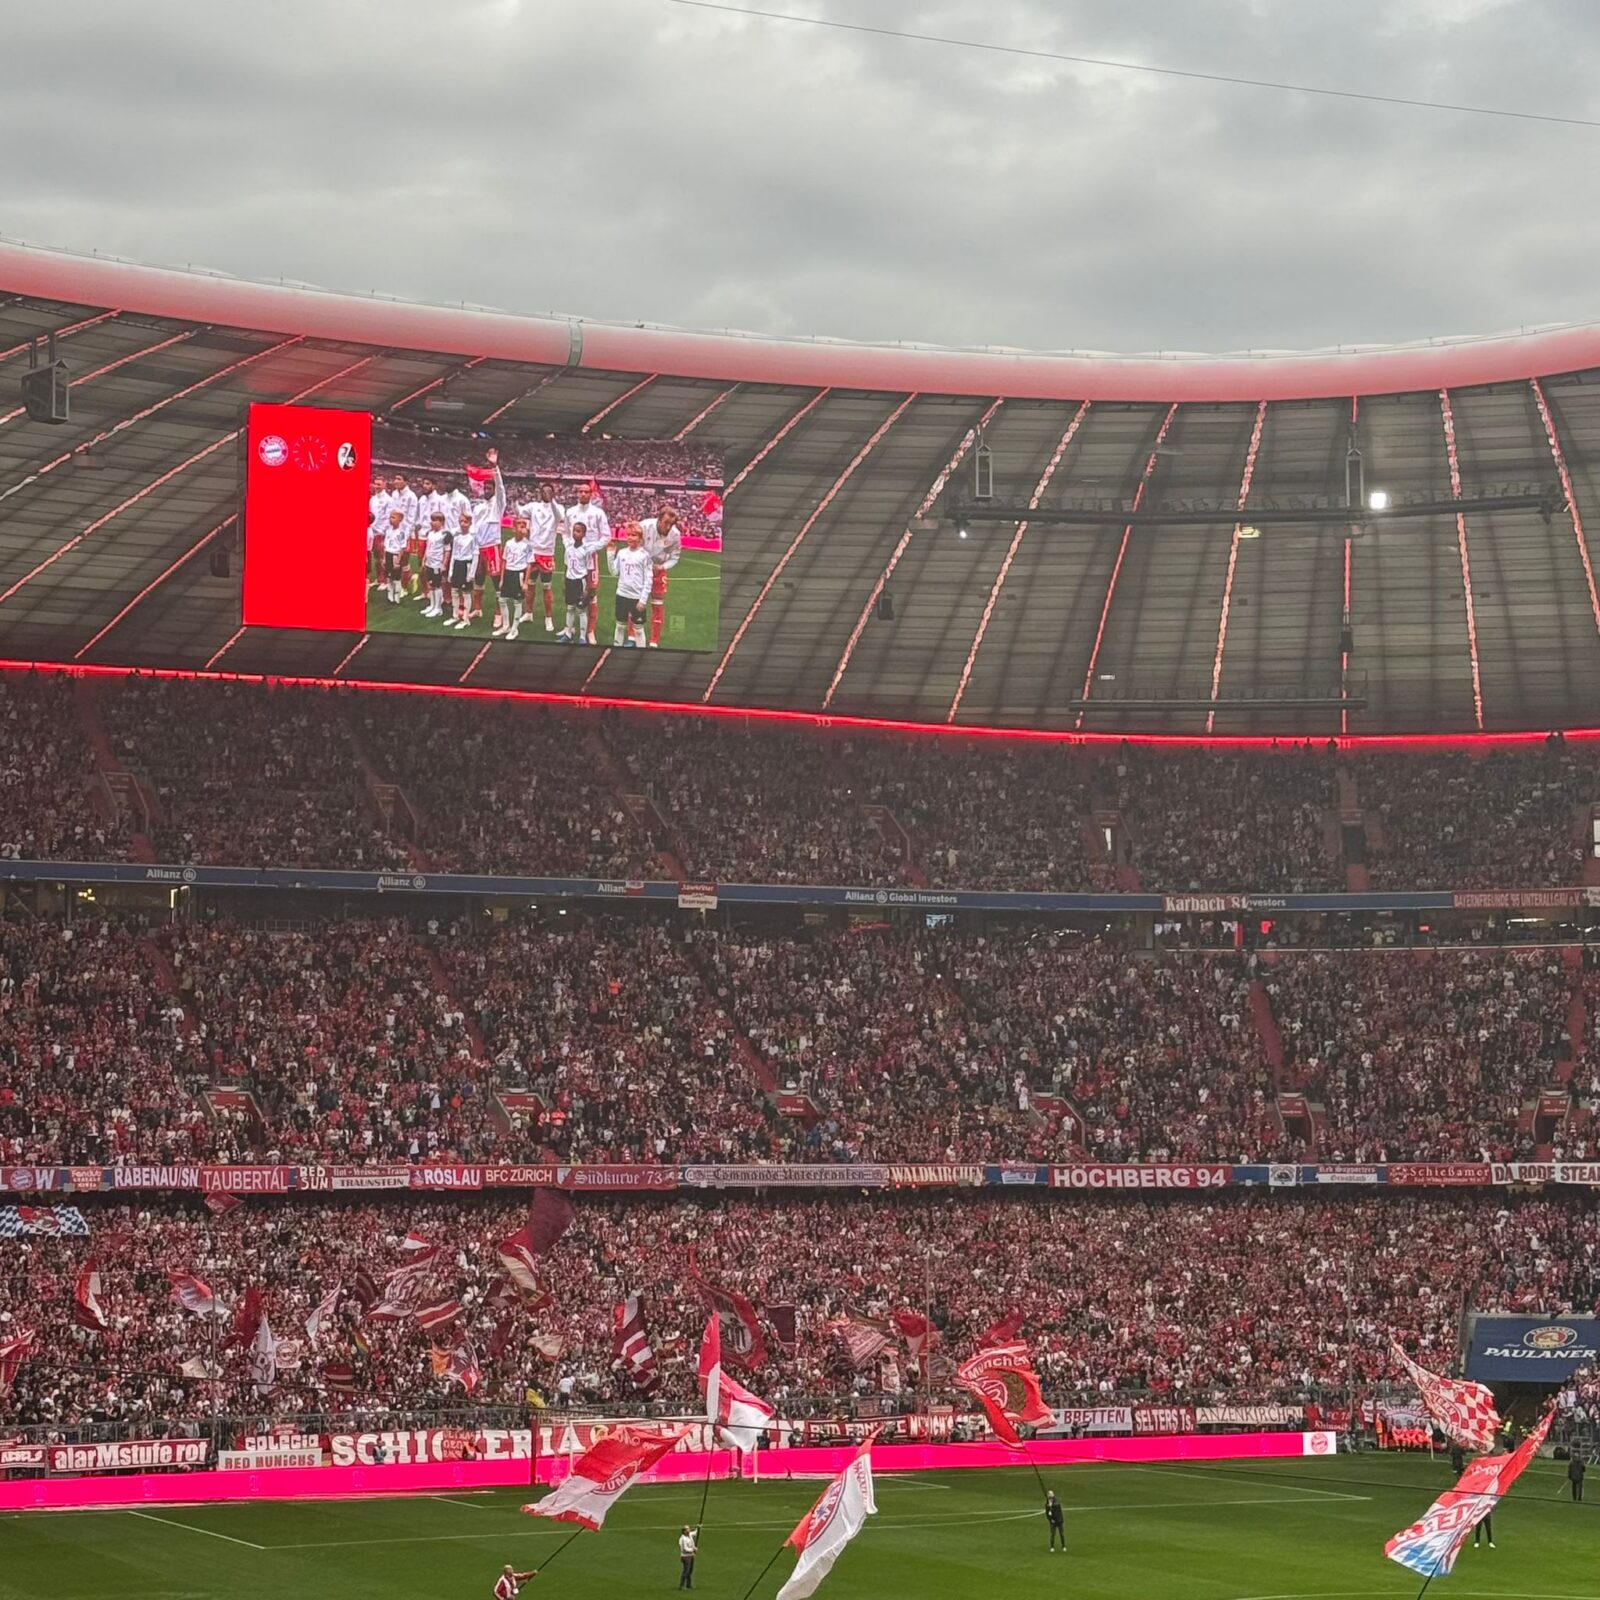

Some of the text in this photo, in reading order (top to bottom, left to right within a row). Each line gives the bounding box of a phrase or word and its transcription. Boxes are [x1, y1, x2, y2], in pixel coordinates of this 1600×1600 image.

[146, 868, 181, 879] Allianz
[377, 876, 410, 886] Allianz
[845, 891, 958, 903] Allianz Global Investors
[1247, 898, 1286, 907] vestors
[1165, 897, 1226, 911] Karbach
[114, 1167, 199, 1187] RABENAU/SN
[300, 1166, 326, 1177] RED
[485, 1169, 509, 1182] BFC
[574, 1170, 640, 1185] Südkurve
[1494, 1166, 1514, 1182] DA
[1560, 1166, 1600, 1182] STEA
[300, 1177, 328, 1190] SUN
[1483, 1347, 1597, 1359] PAULANER
[1064, 1409, 1125, 1424] BRETTEN
[1135, 1409, 1179, 1431] SELTERS
[176, 1441, 207, 1463] rot
[331, 1425, 585, 1467] SCHIERIA
[225, 1457, 250, 1470] RED
